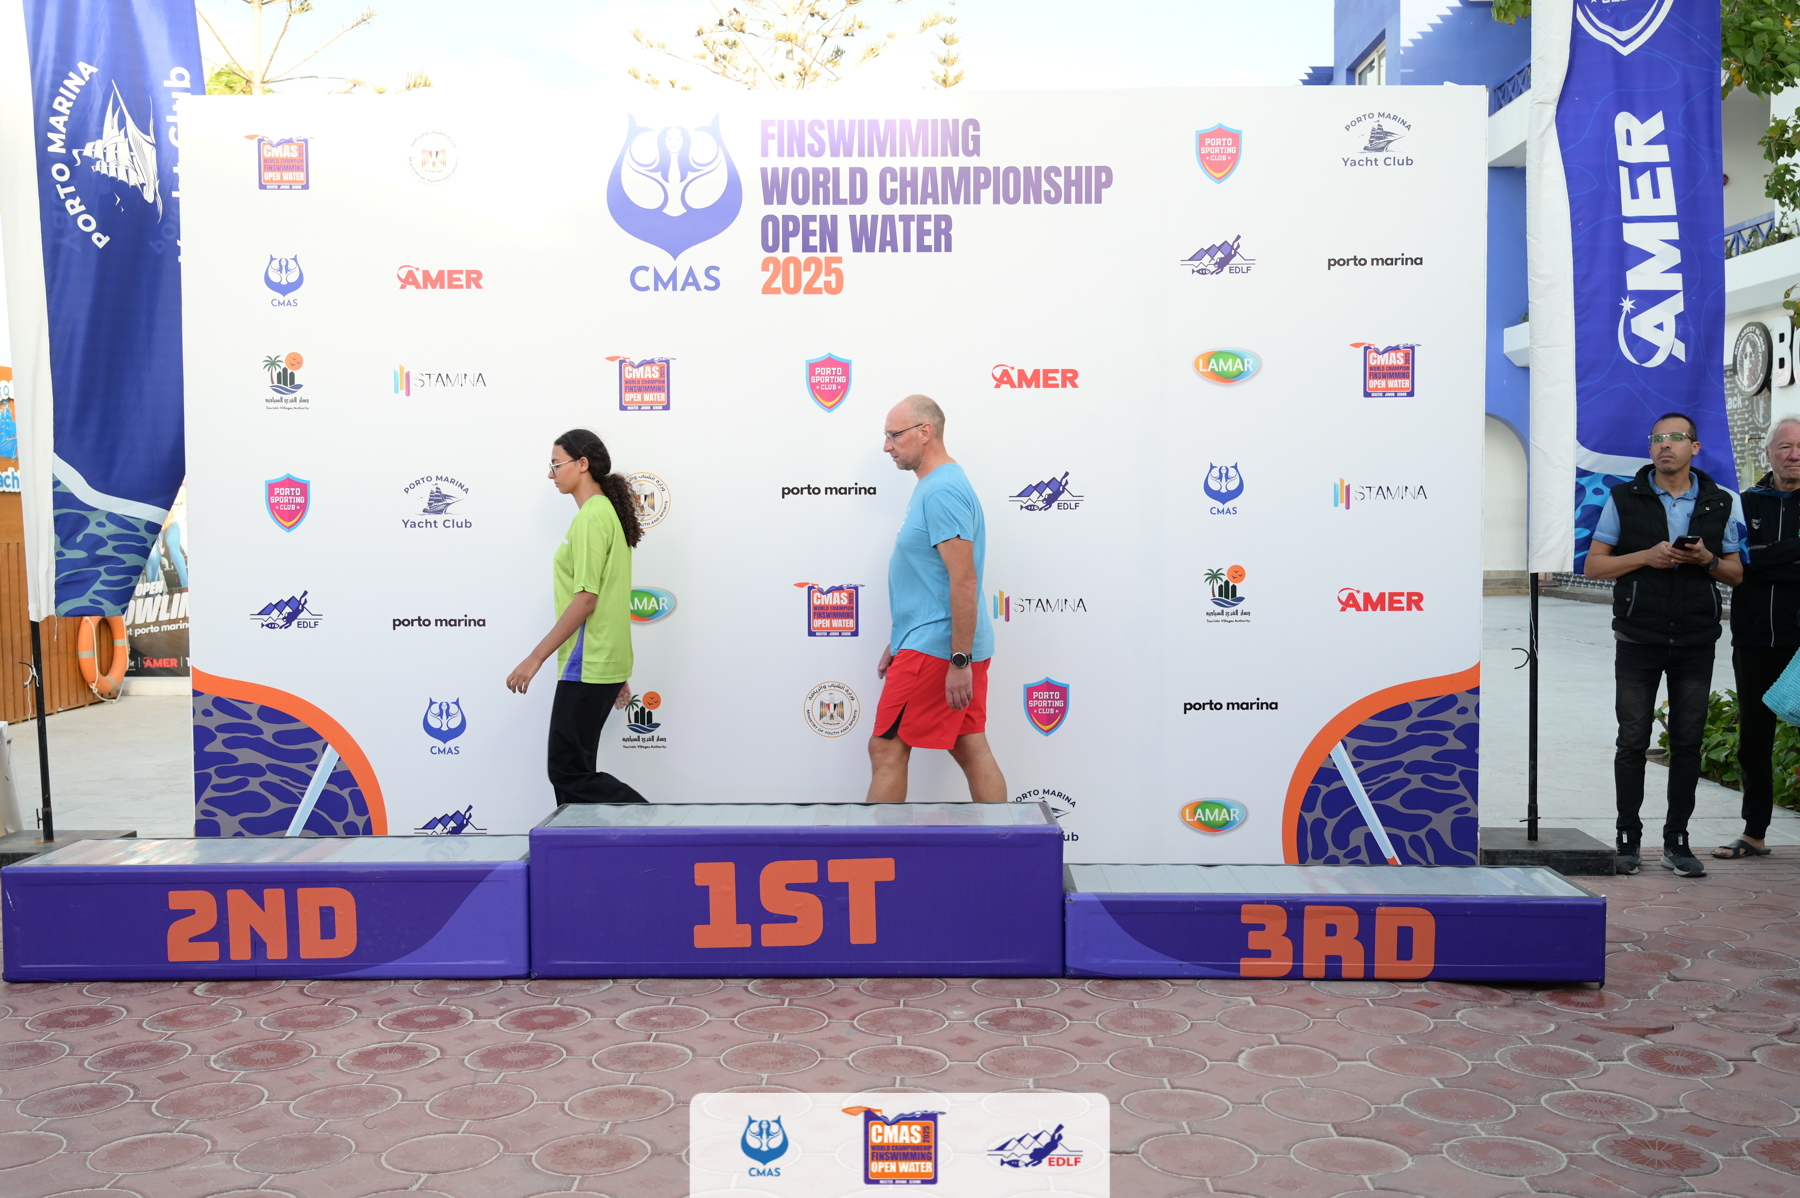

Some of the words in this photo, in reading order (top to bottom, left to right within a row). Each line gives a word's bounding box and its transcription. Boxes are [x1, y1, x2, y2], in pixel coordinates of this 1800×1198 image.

[47, 61, 99, 154] MARINA
[1344, 112, 1374, 131] PORTO
[1378, 112, 1412, 131] MARINA
[761, 118, 980, 158] FINSWIMMING
[264, 145, 298, 157] CMAS
[1342, 157, 1379, 166] Yacht
[1384, 156, 1414, 166] Club
[264, 172, 280, 180] OPEN
[282, 172, 304, 180] WATER
[761, 166, 868, 205] WORLD
[879, 164, 1113, 205] CHAMPIONSHIP
[52, 162, 111, 249] PORTO
[761, 214, 838, 253] OPEN
[849, 214, 952, 253] WATER
[1614, 110, 1686, 368] AMER
[1328, 255, 1367, 270] porto
[1371, 253, 1423, 266] marina
[397, 265, 483, 289] AMER
[629, 266, 720, 291] CMAS
[761, 255, 844, 296] 2025
[270, 299, 298, 307] CMAS
[1199, 358, 1254, 372] LAMAR
[1369, 352, 1404, 365] CMAS
[414, 372, 486, 387] STAMINA
[625, 366, 659, 378] CMAS
[992, 364, 1079, 388] AMER
[1369, 380, 1386, 388] OPEN
[1388, 380, 1409, 388] WATER
[625, 393, 641, 401] OPEN
[643, 393, 665, 401] WATER
[1726, 392, 1742, 410] ack
[404, 476, 432, 494] PORTO
[436, 475, 469, 494] MARINA
[782, 484, 821, 499] porto
[824, 482, 876, 495] marina
[1354, 485, 1427, 500] STAMINA
[1210, 507, 1238, 515] CMAS
[402, 519, 438, 528] Yacht
[443, 519, 472, 528] Club
[135, 581, 164, 596] OPEN
[814, 592, 848, 605] CMAS
[1014, 598, 1087, 613] STAMINA
[1337, 587, 1424, 612] AMER
[135, 625, 159, 637] porto
[161, 621, 190, 631] marin
[297, 621, 319, 629] EDLF
[393, 616, 431, 630] porto
[435, 614, 486, 627] marina
[814, 619, 830, 627] OPEN
[832, 619, 854, 627] WATER
[143, 656, 178, 668] AMER
[1184, 700, 1223, 715] porto
[1227, 697, 1278, 711] marina
[807, 710, 818, 729] MINISTRY
[849, 710, 857, 726] SPORTS
[430, 746, 460, 755] CMAS
[1012, 789, 1039, 802] ORTO
[1042, 789, 1076, 808] MARINA
[1185, 808, 1240, 822] LAMAR
[1063, 832, 1079, 841] ub
[693, 858, 895, 950] 1ST
[167, 887, 358, 962] 2ND
[1240, 904, 1436, 980] 3RD
